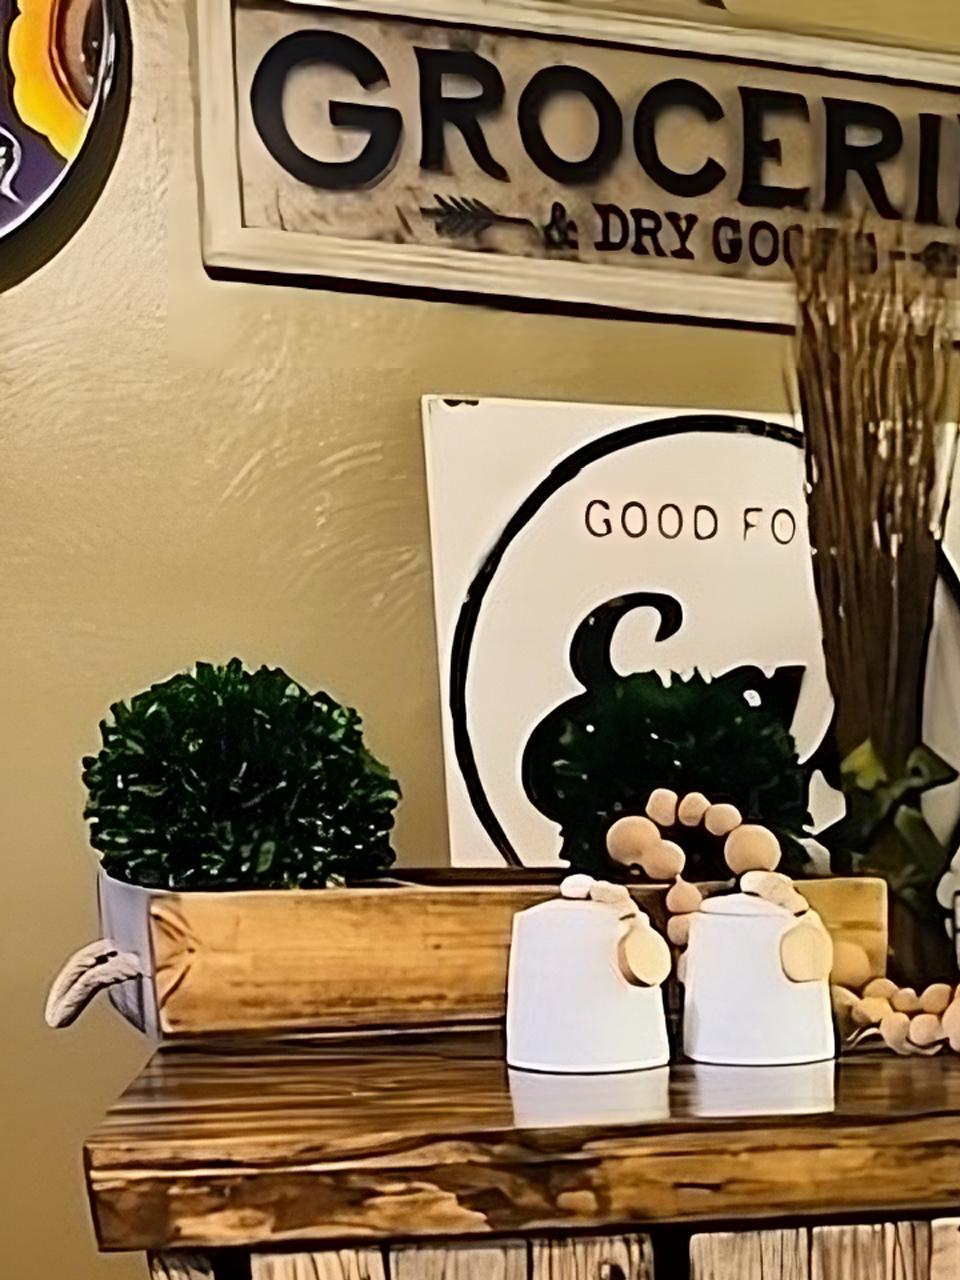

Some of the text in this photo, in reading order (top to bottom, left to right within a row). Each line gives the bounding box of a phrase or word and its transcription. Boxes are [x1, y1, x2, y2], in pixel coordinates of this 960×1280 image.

[543, 201, 580, 250] &
[591, 202, 699, 260] DRY
[584, 499, 797, 546] GOOD FO
